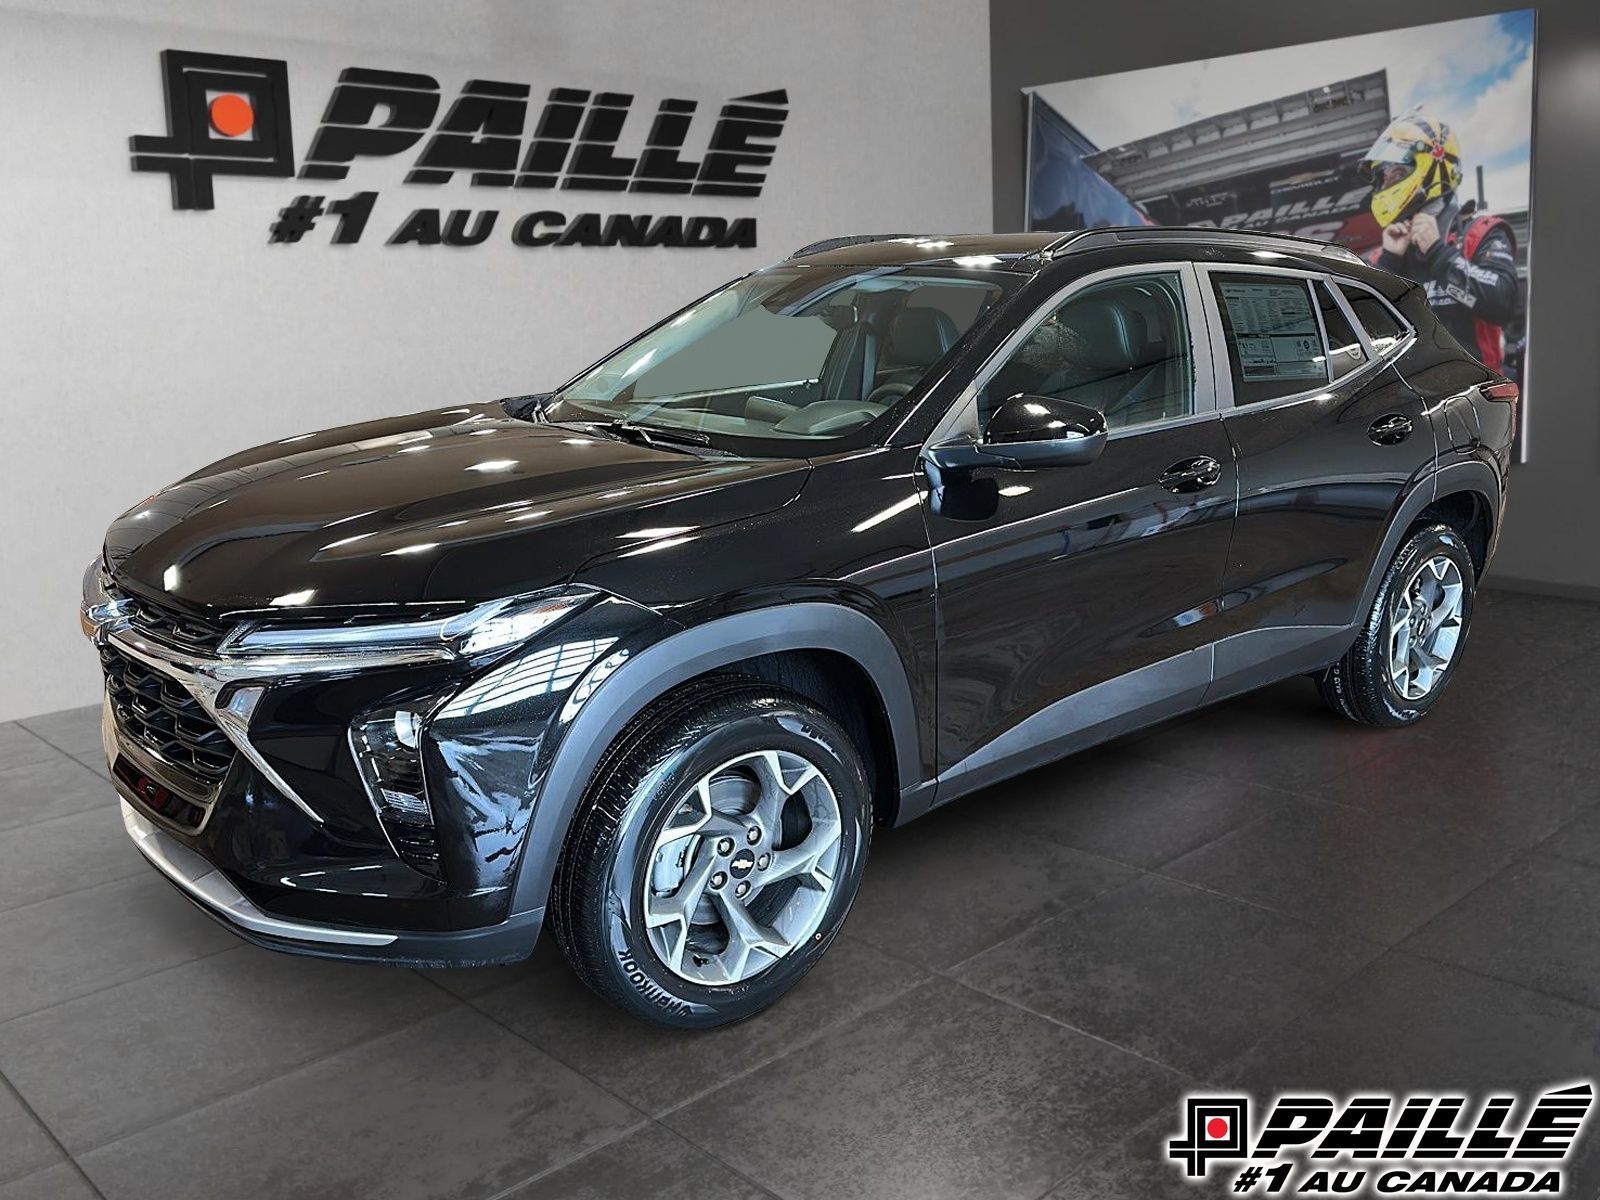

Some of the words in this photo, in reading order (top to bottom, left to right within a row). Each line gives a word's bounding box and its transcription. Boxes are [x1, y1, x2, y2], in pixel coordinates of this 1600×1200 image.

[296, 67, 789, 197] PAILLÉ
[1270, 176, 1340, 195] CHEVROLET
[267, 191, 379, 245] #1
[385, 209, 499, 246] AU
[511, 211, 758, 248] CANADA
